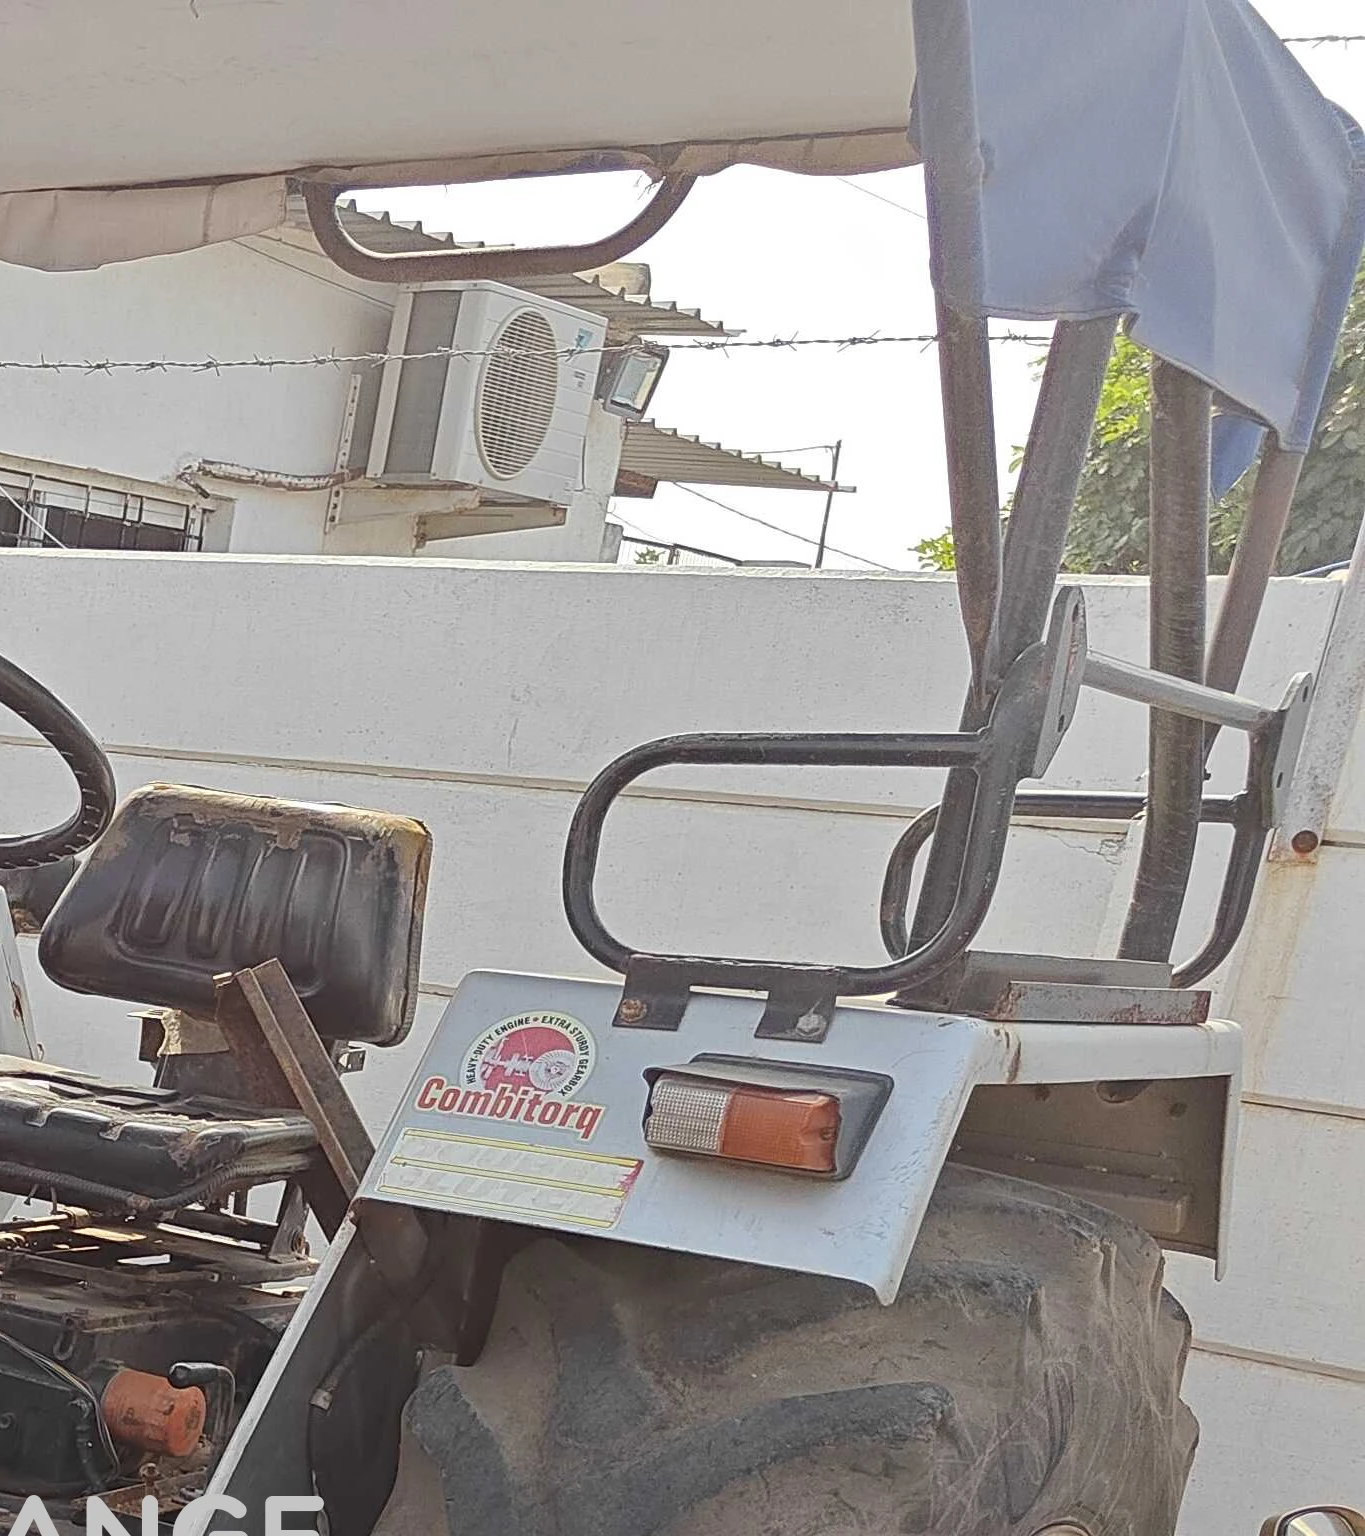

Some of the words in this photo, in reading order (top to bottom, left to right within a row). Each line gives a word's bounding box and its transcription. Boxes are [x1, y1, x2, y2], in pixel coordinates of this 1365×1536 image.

[495, 1016, 531, 1036] ENGINE
[541, 1015, 572, 1030] EXTRA
[466, 1032, 495, 1084] HEAVY-DUTY
[570, 1027, 590, 1057] STURDY
[558, 1059, 589, 1096] GEARBOX
[417, 1078, 604, 1139] Combitorq
